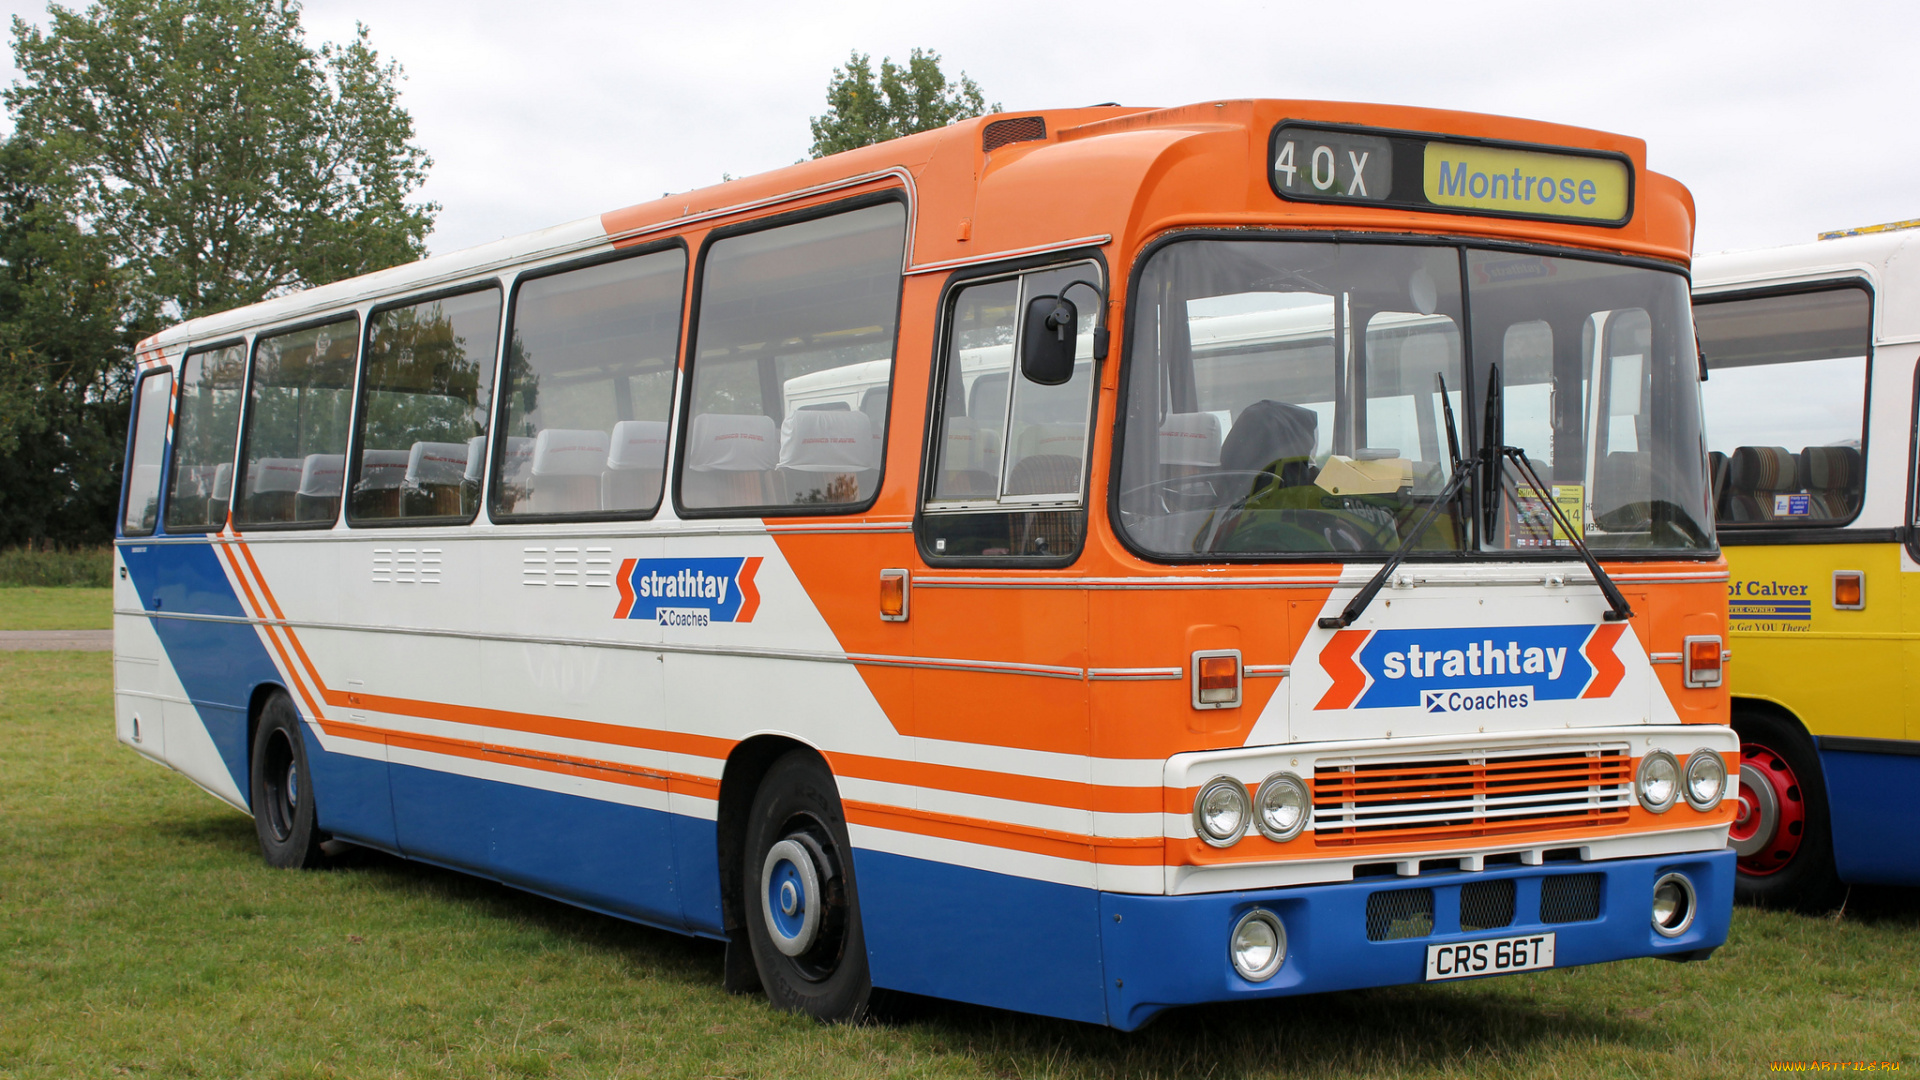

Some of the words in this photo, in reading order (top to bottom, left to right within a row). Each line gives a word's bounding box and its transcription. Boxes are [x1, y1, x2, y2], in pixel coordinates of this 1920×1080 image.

[1437, 161, 1596, 205] Montrose
[640, 568, 728, 604] strathtay
[1729, 581, 1743, 596] of
[1746, 581, 1808, 596] Calver
[668, 610, 708, 627] Coaches
[1737, 622, 1752, 631] Get
[1754, 623, 1777, 632] YOU
[1781, 623, 1811, 632] There!
[1383, 640, 1567, 680] strathtay
[1448, 690, 1529, 711] Coaches
[1436, 943, 1488, 975] CRS
[1495, 937, 1544, 968] 66T
